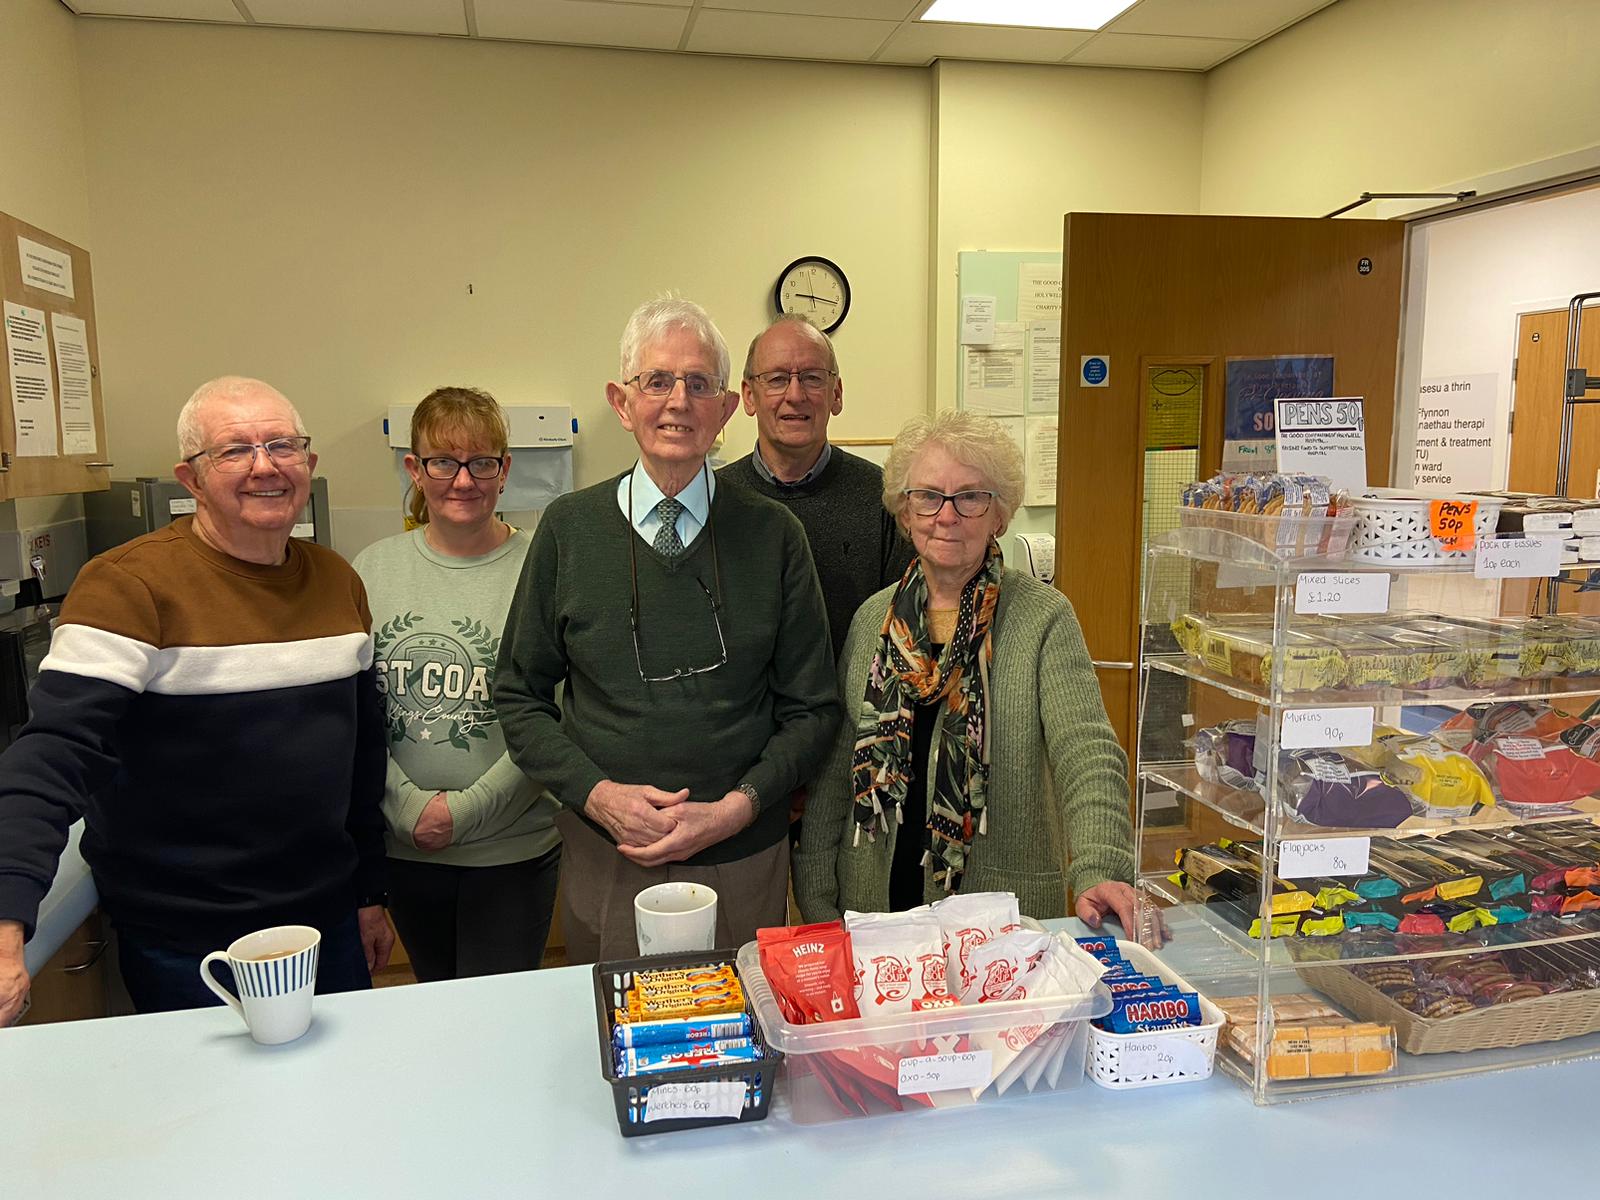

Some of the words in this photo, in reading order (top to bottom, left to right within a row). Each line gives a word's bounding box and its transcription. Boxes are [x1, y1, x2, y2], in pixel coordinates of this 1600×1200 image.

[1451, 381, 1471, 391] thrin
[1253, 411, 1274, 432] SO
[1284, 402, 1333, 425] PENS
[1336, 401, 1364, 432] 50p
[1418, 420, 1451, 430] naethau
[1454, 418, 1486, 430] therapi
[1441, 437, 1447, 446] &
[1449, 437, 1492, 447] treatment
[1422, 462, 1442, 471] ward
[1422, 475, 1452, 484] service
[1439, 518, 1463, 533] 50p
[1298, 575, 1326, 585] Mixed
[376, 660, 413, 696] ST
[421, 661, 490, 701] COA
[1324, 727, 1344, 741] 90p
[1282, 841, 1326, 857] Flapjacks
[1332, 856, 1348, 870] 80p
[792, 943, 825, 958] HEINZ
[921, 999, 954, 1009] OXO
[1126, 999, 1189, 1023] HARIBO
[1157, 1053, 1174, 1063] 20p
